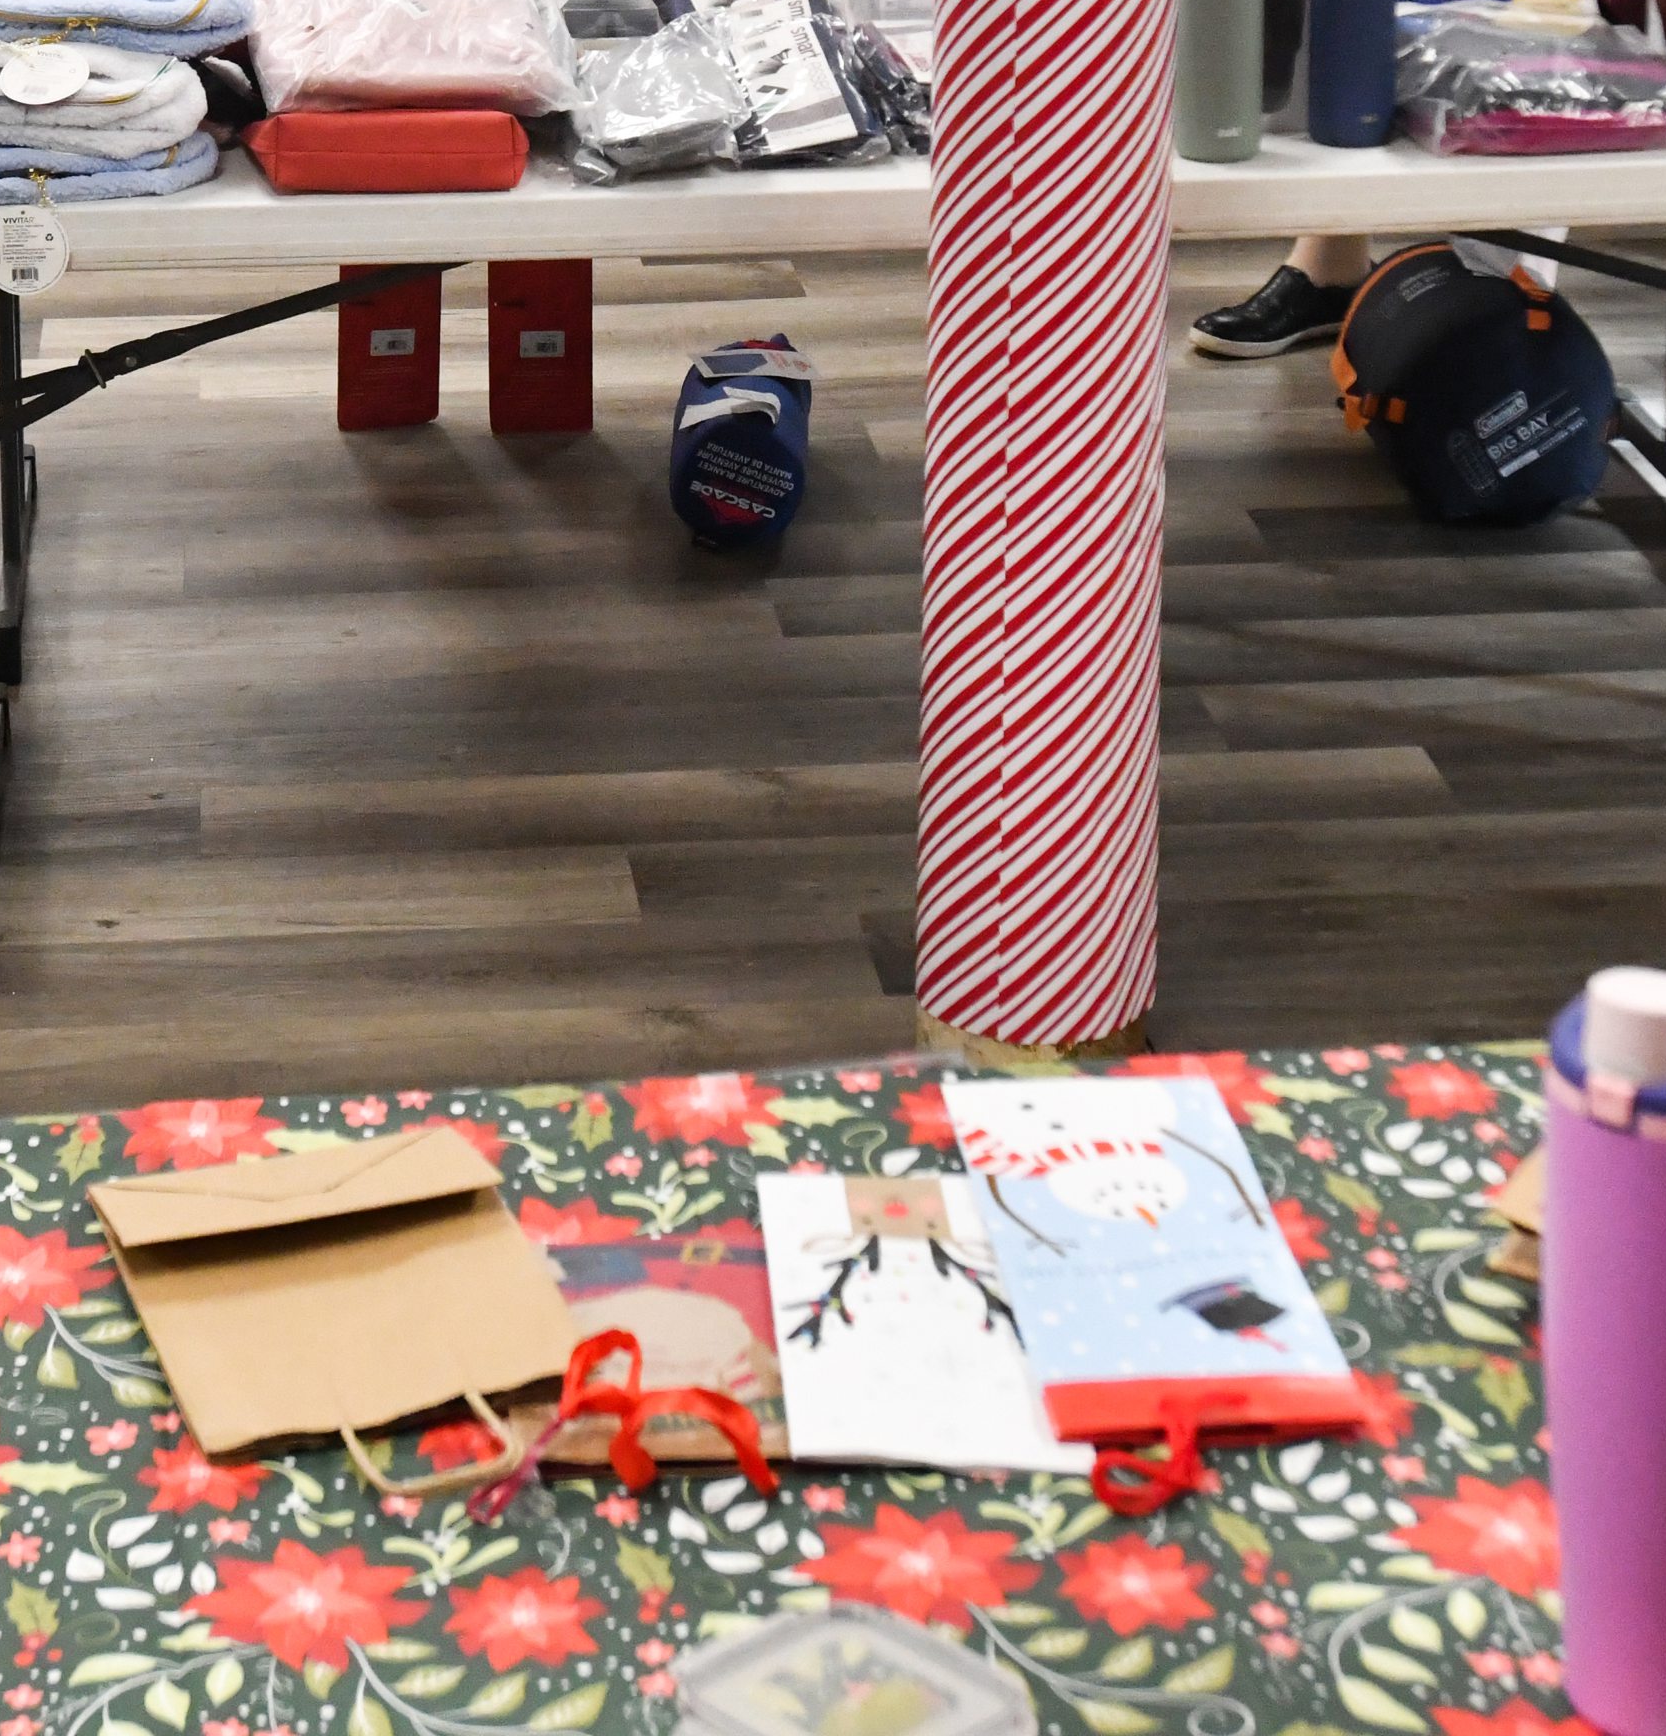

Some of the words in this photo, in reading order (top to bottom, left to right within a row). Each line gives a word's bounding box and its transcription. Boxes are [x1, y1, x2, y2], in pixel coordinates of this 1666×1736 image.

[790, 25, 820, 61] smart
[1487, 434, 1519, 461] BIG
[1516, 411, 1549, 441] BAY
[697, 450, 741, 472] AVENTURE
[706, 442, 751, 464] AVENTURA
[752, 458, 763, 470] DE
[699, 461, 734, 482] BLANKET
[742, 469, 795, 491] COUVERTURE
[764, 463, 793, 480] MANTA
[737, 478, 787, 497] ADVENTURE
[689, 480, 776, 519] CASCADE
